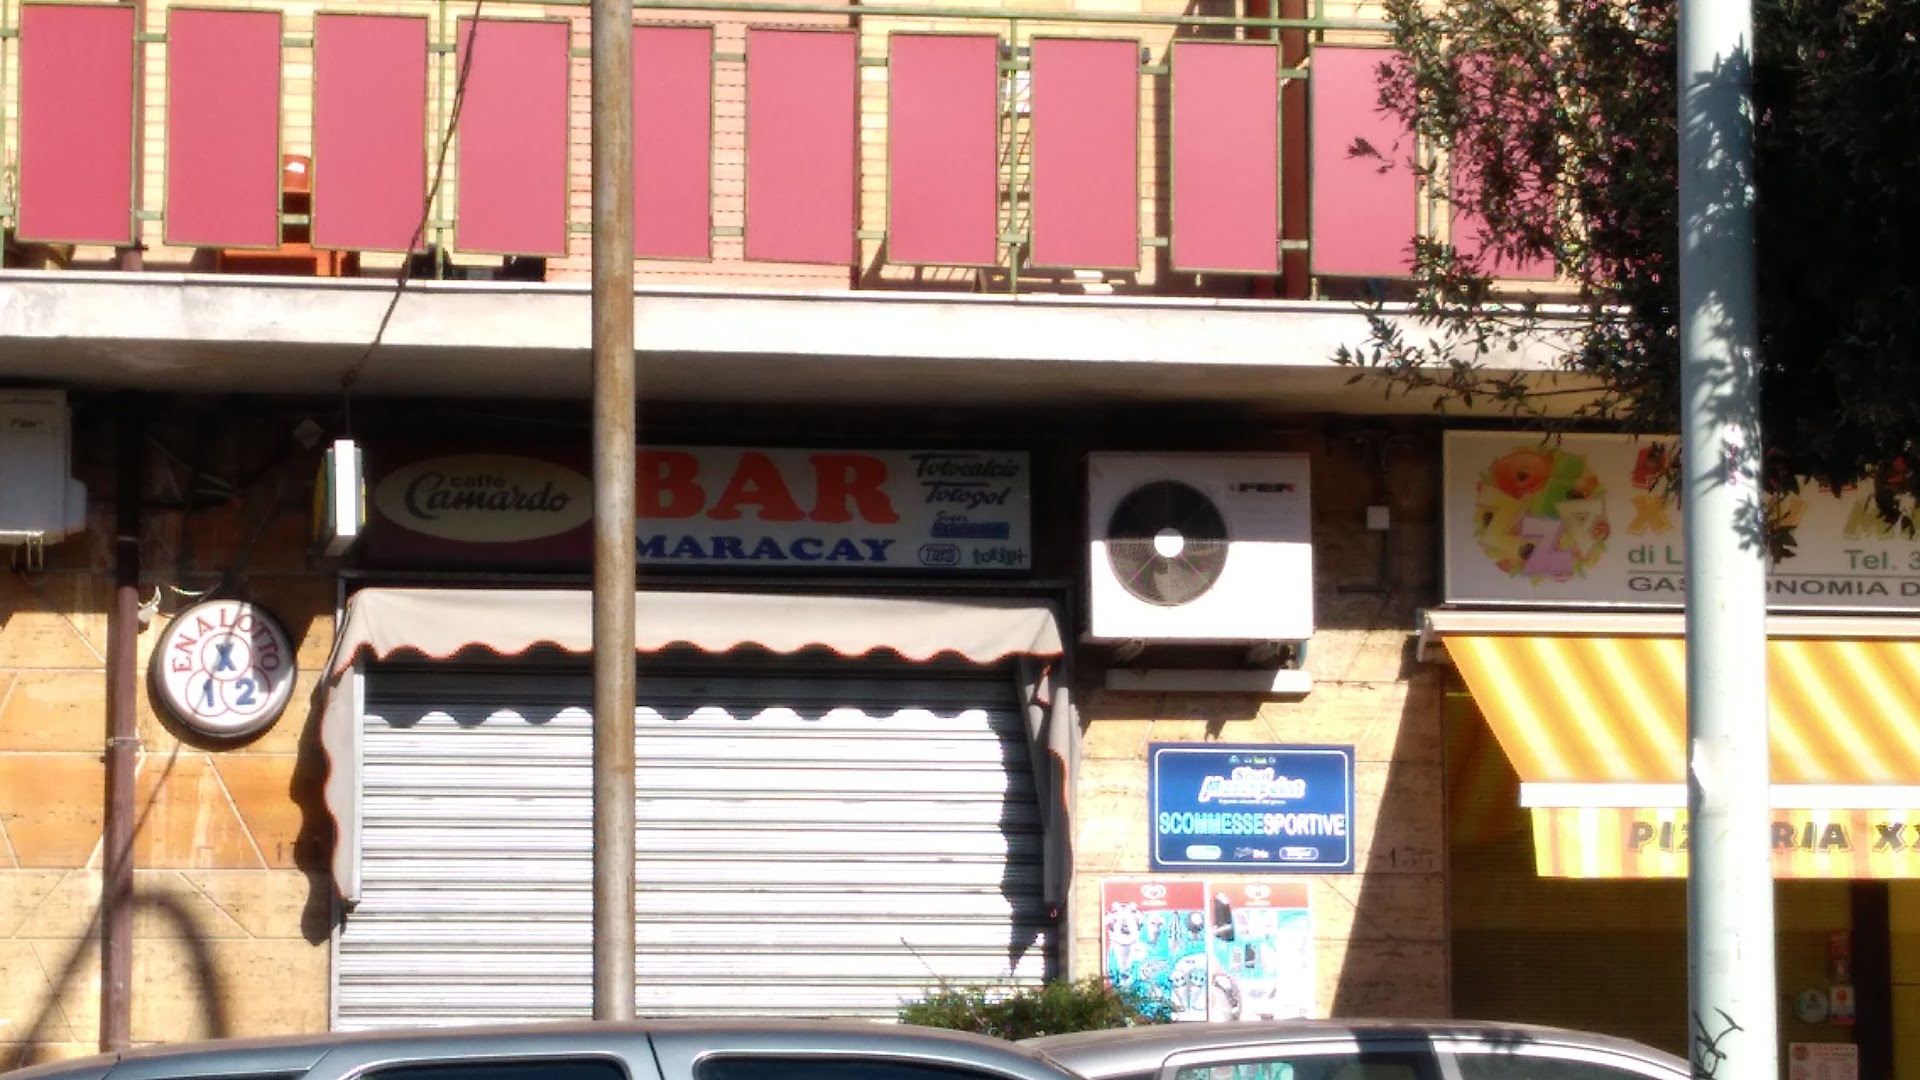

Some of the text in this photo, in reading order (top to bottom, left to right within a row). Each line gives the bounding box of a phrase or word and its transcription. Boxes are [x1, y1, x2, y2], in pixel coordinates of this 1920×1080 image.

[404, 471, 572, 520] Camardo
[636, 450, 900, 525] BAR
[1628, 545, 1654, 565] di
[172, 608, 280, 673] ENALOTTO
[216, 643, 236, 671] X
[202, 677, 256, 708] 1 2
